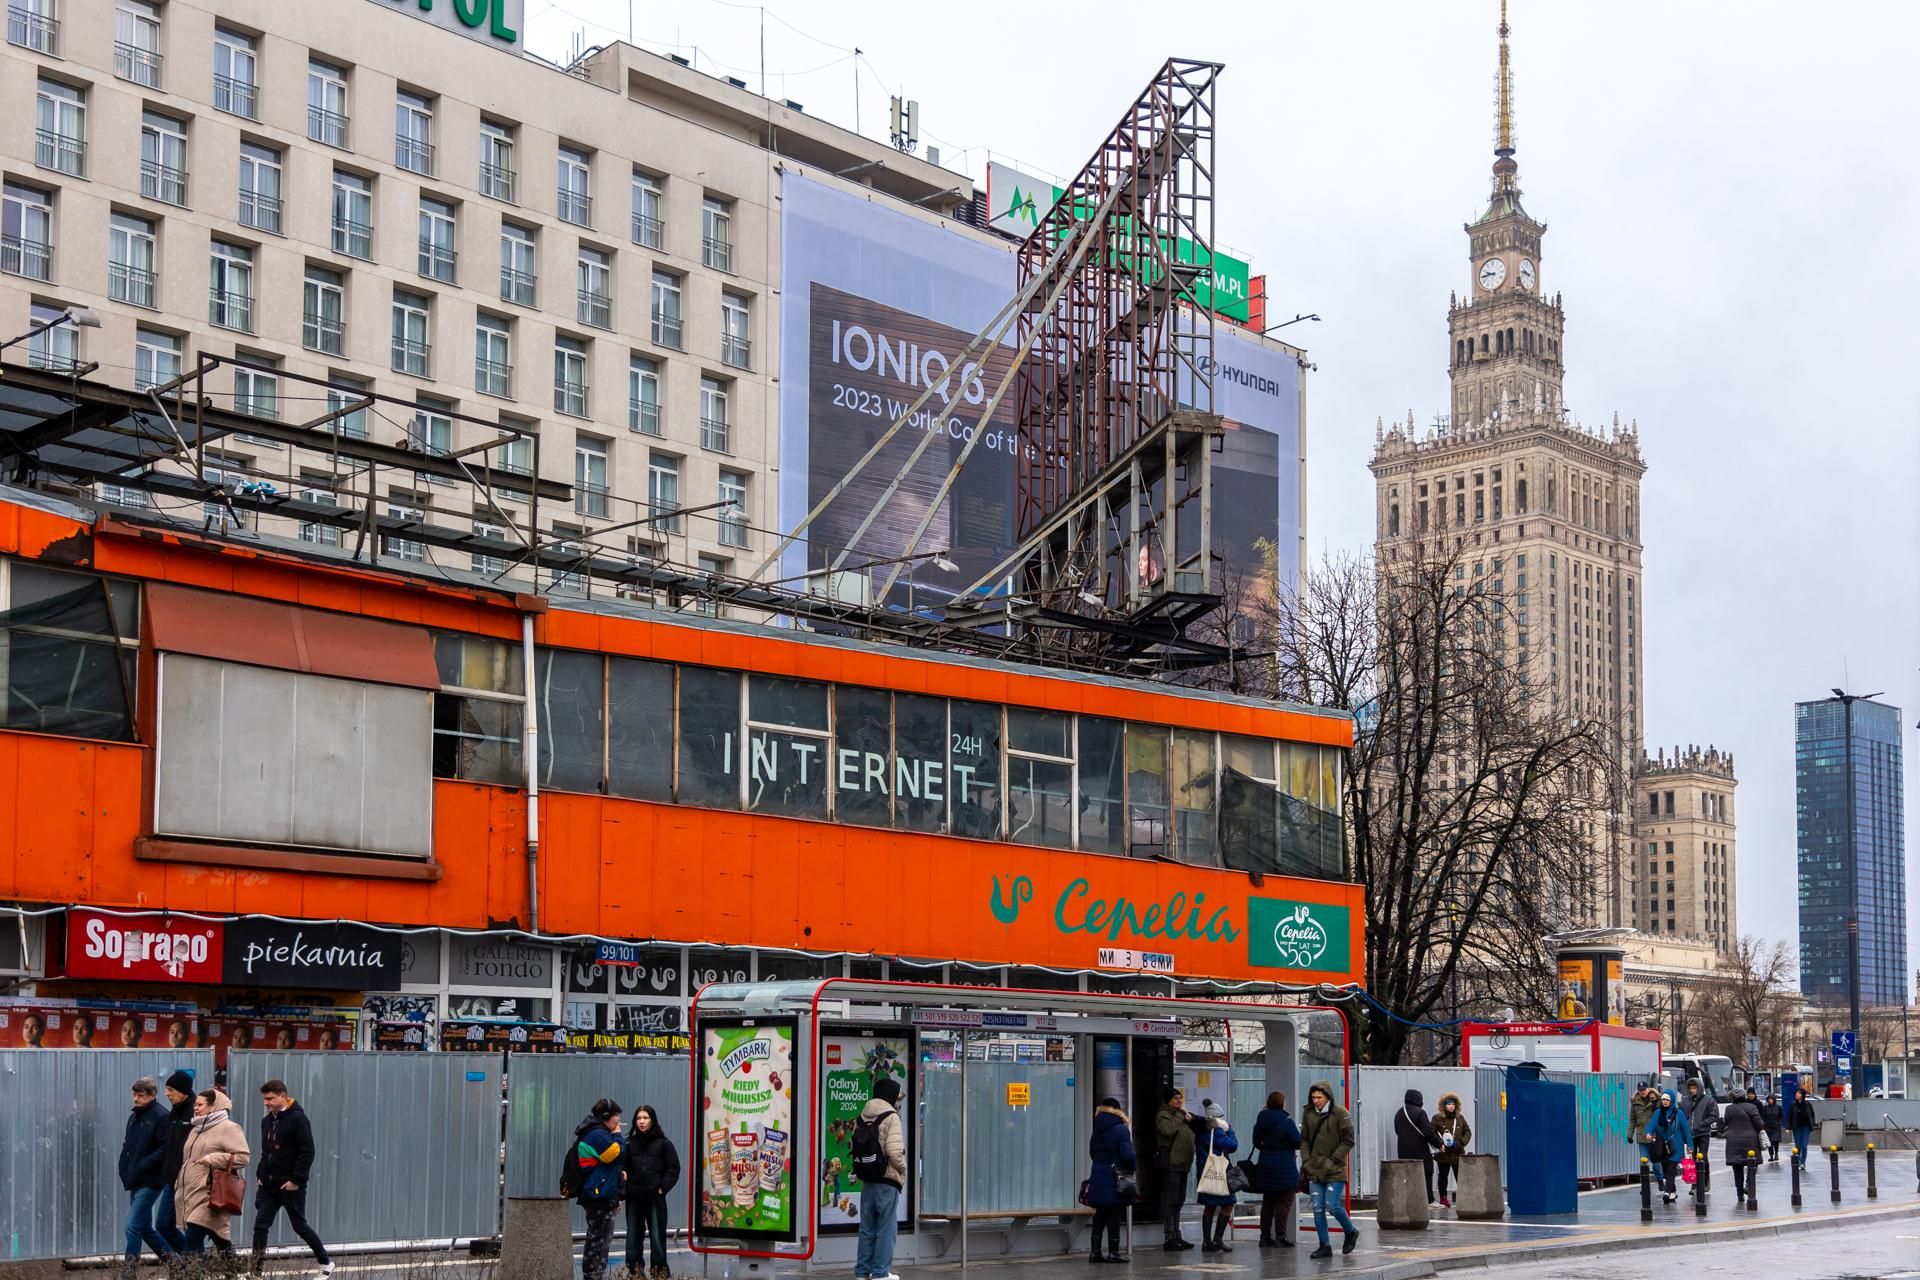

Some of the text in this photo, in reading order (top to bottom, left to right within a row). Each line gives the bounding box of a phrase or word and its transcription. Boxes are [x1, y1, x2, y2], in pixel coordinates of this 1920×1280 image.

[832, 319, 951, 405] IONIQ
[1223, 364, 1279, 397] HYUNDAI
[833, 383, 883, 417] 2023
[986, 429, 1004, 451] of
[952, 733, 982, 757] 24H
[723, 732, 976, 804] INTERNET
[1054, 877, 1241, 944] Cepelia
[1281, 924, 1321, 942] Cepelia
[242, 931, 385, 974] piekarnia
[473, 945, 543, 961] GALERIA
[601, 944, 634, 961] 99/101
[1288, 941, 1312, 967] 50
[1299, 942, 1310, 950] LAT
[474, 961, 543, 979] rondo
[1151, 1025, 1175, 1033] Centrum
[594, 1034, 629, 1049] PUNK FEST
[634, 1034, 668, 1049] PUNK FEST
[723, 1042, 767, 1072] TYMBARK
[732, 1079, 760, 1092] KIEDY
[828, 1078, 859, 1092] Odkryj
[721, 1088, 773, 1105] MUUUSISZ
[830, 1089, 869, 1101] Nowości
[840, 1102, 858, 1111] 2024
